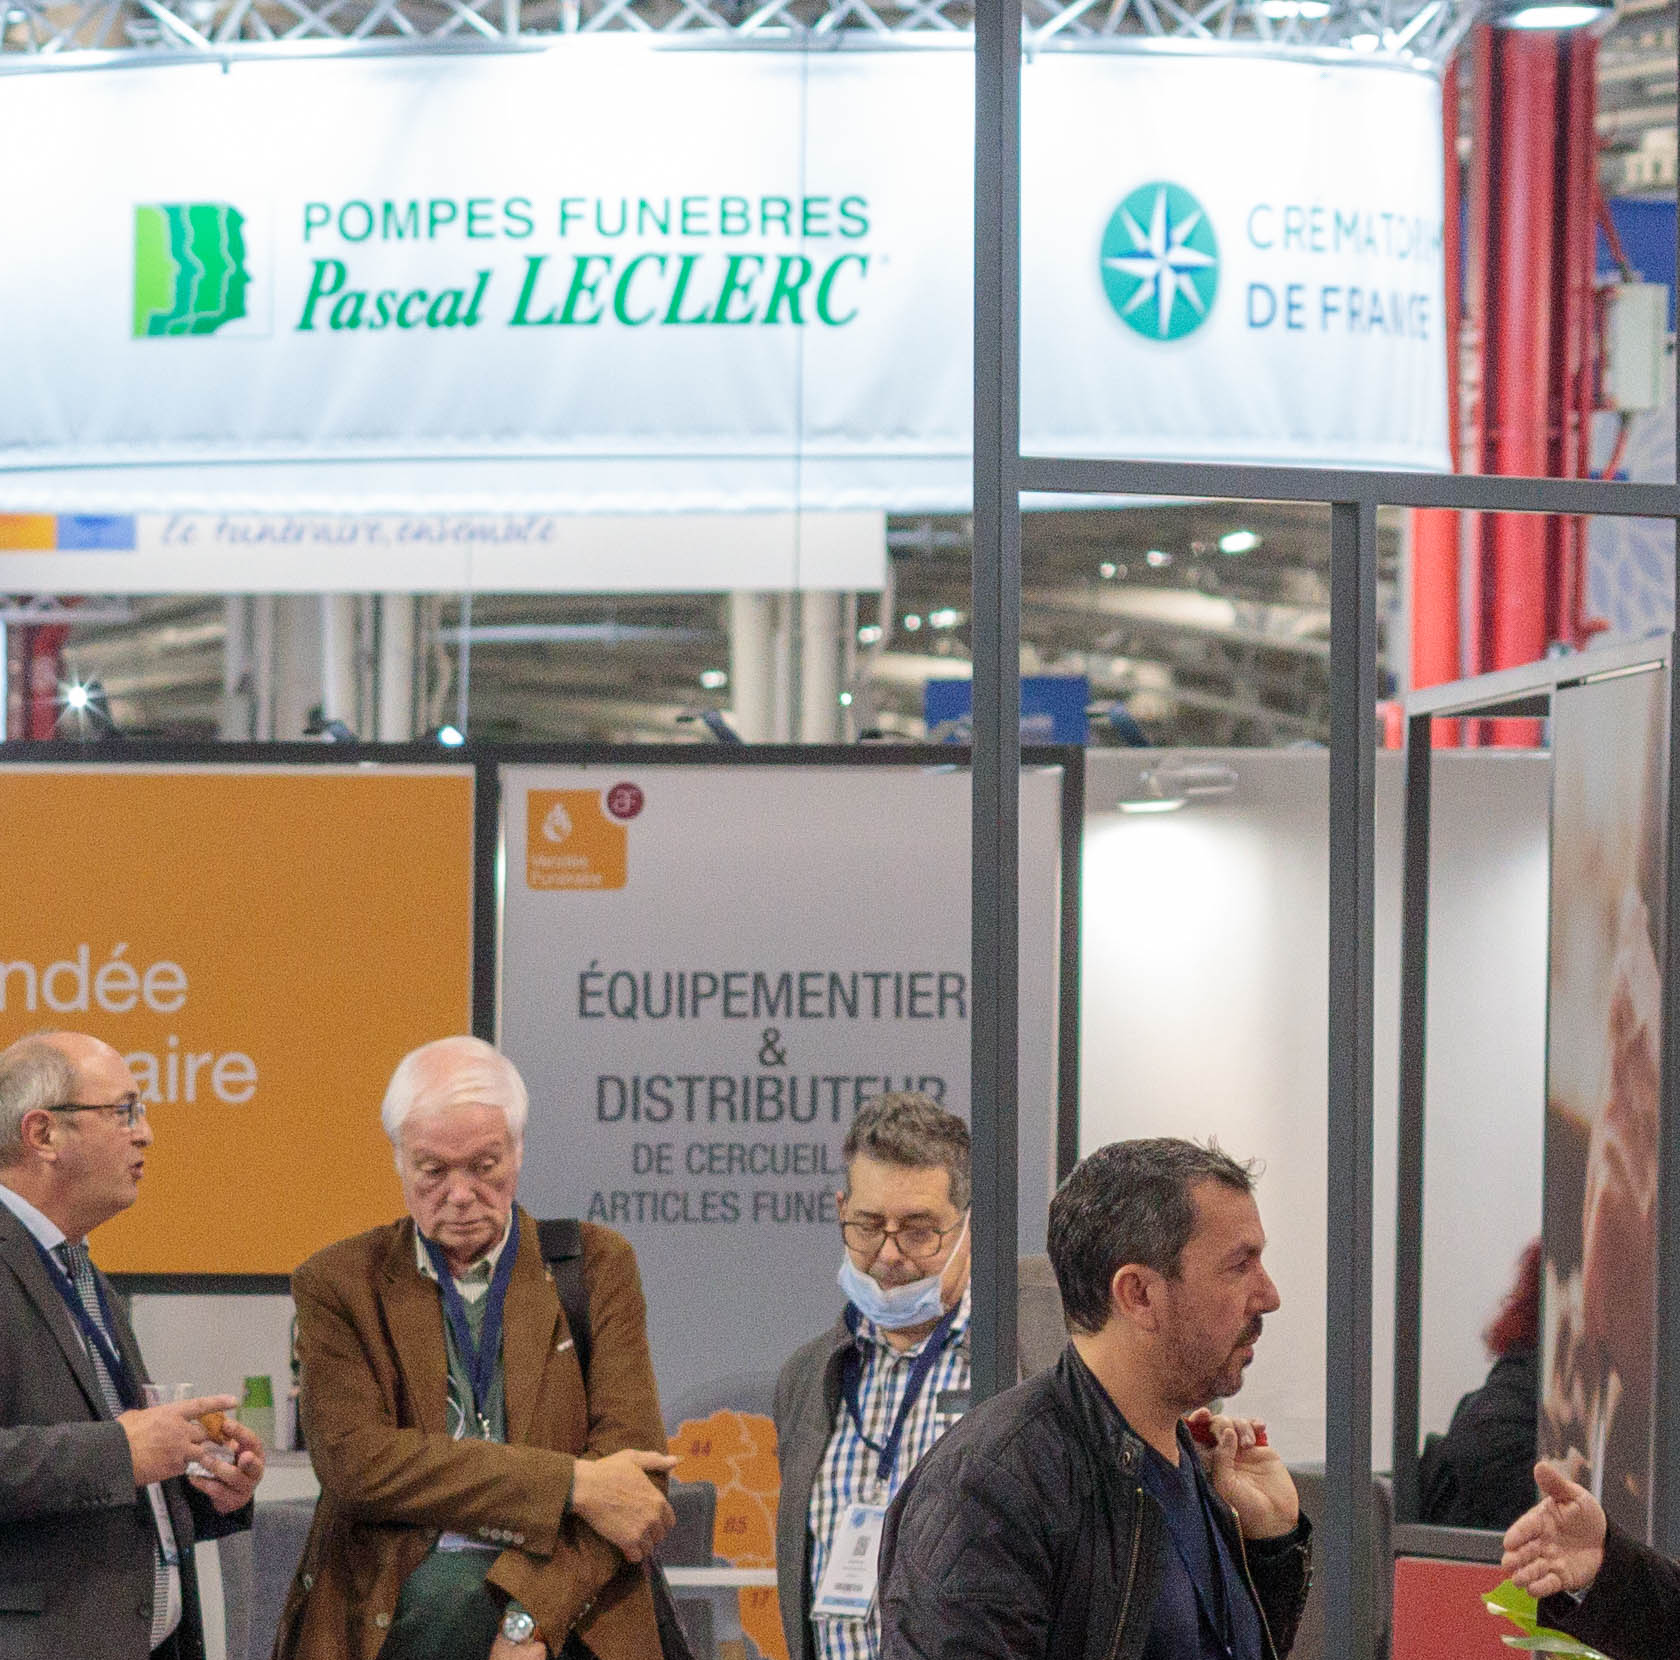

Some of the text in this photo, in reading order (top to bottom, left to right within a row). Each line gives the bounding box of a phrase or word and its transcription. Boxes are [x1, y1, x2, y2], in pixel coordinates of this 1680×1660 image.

[301, 196, 870, 243] POMPES FUNEBRES
[296, 252, 871, 334] Pascal LECLERC
[1245, 281, 1306, 332] DE
[576, 959, 969, 1022] ÉQUIPEMENTIER
[757, 1027, 788, 1068] &
[631, 1142, 843, 1176] DE CERCUEIL
[587, 1190, 742, 1225] ARTICLES
